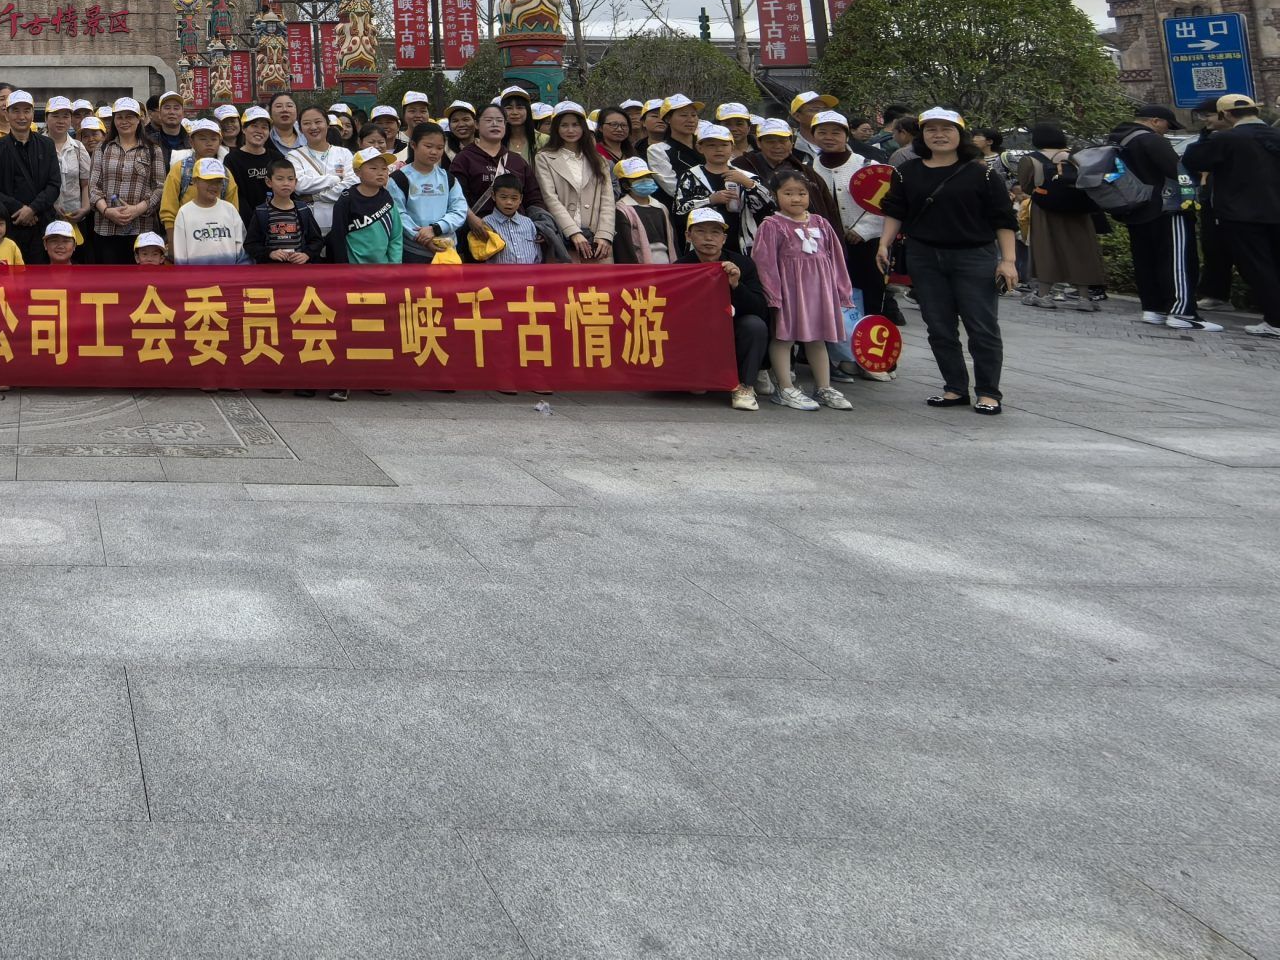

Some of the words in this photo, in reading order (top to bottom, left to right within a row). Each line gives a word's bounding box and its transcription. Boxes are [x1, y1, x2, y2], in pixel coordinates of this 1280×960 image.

[1175, 20, 1228, 38] 出口
[289, 28, 304, 83] 三峡千古情
[862, 179, 891, 209] 1
[348, 214, 373, 231] FILA
[371, 202, 392, 220] TENNIS
[867, 324, 890, 358] 5
